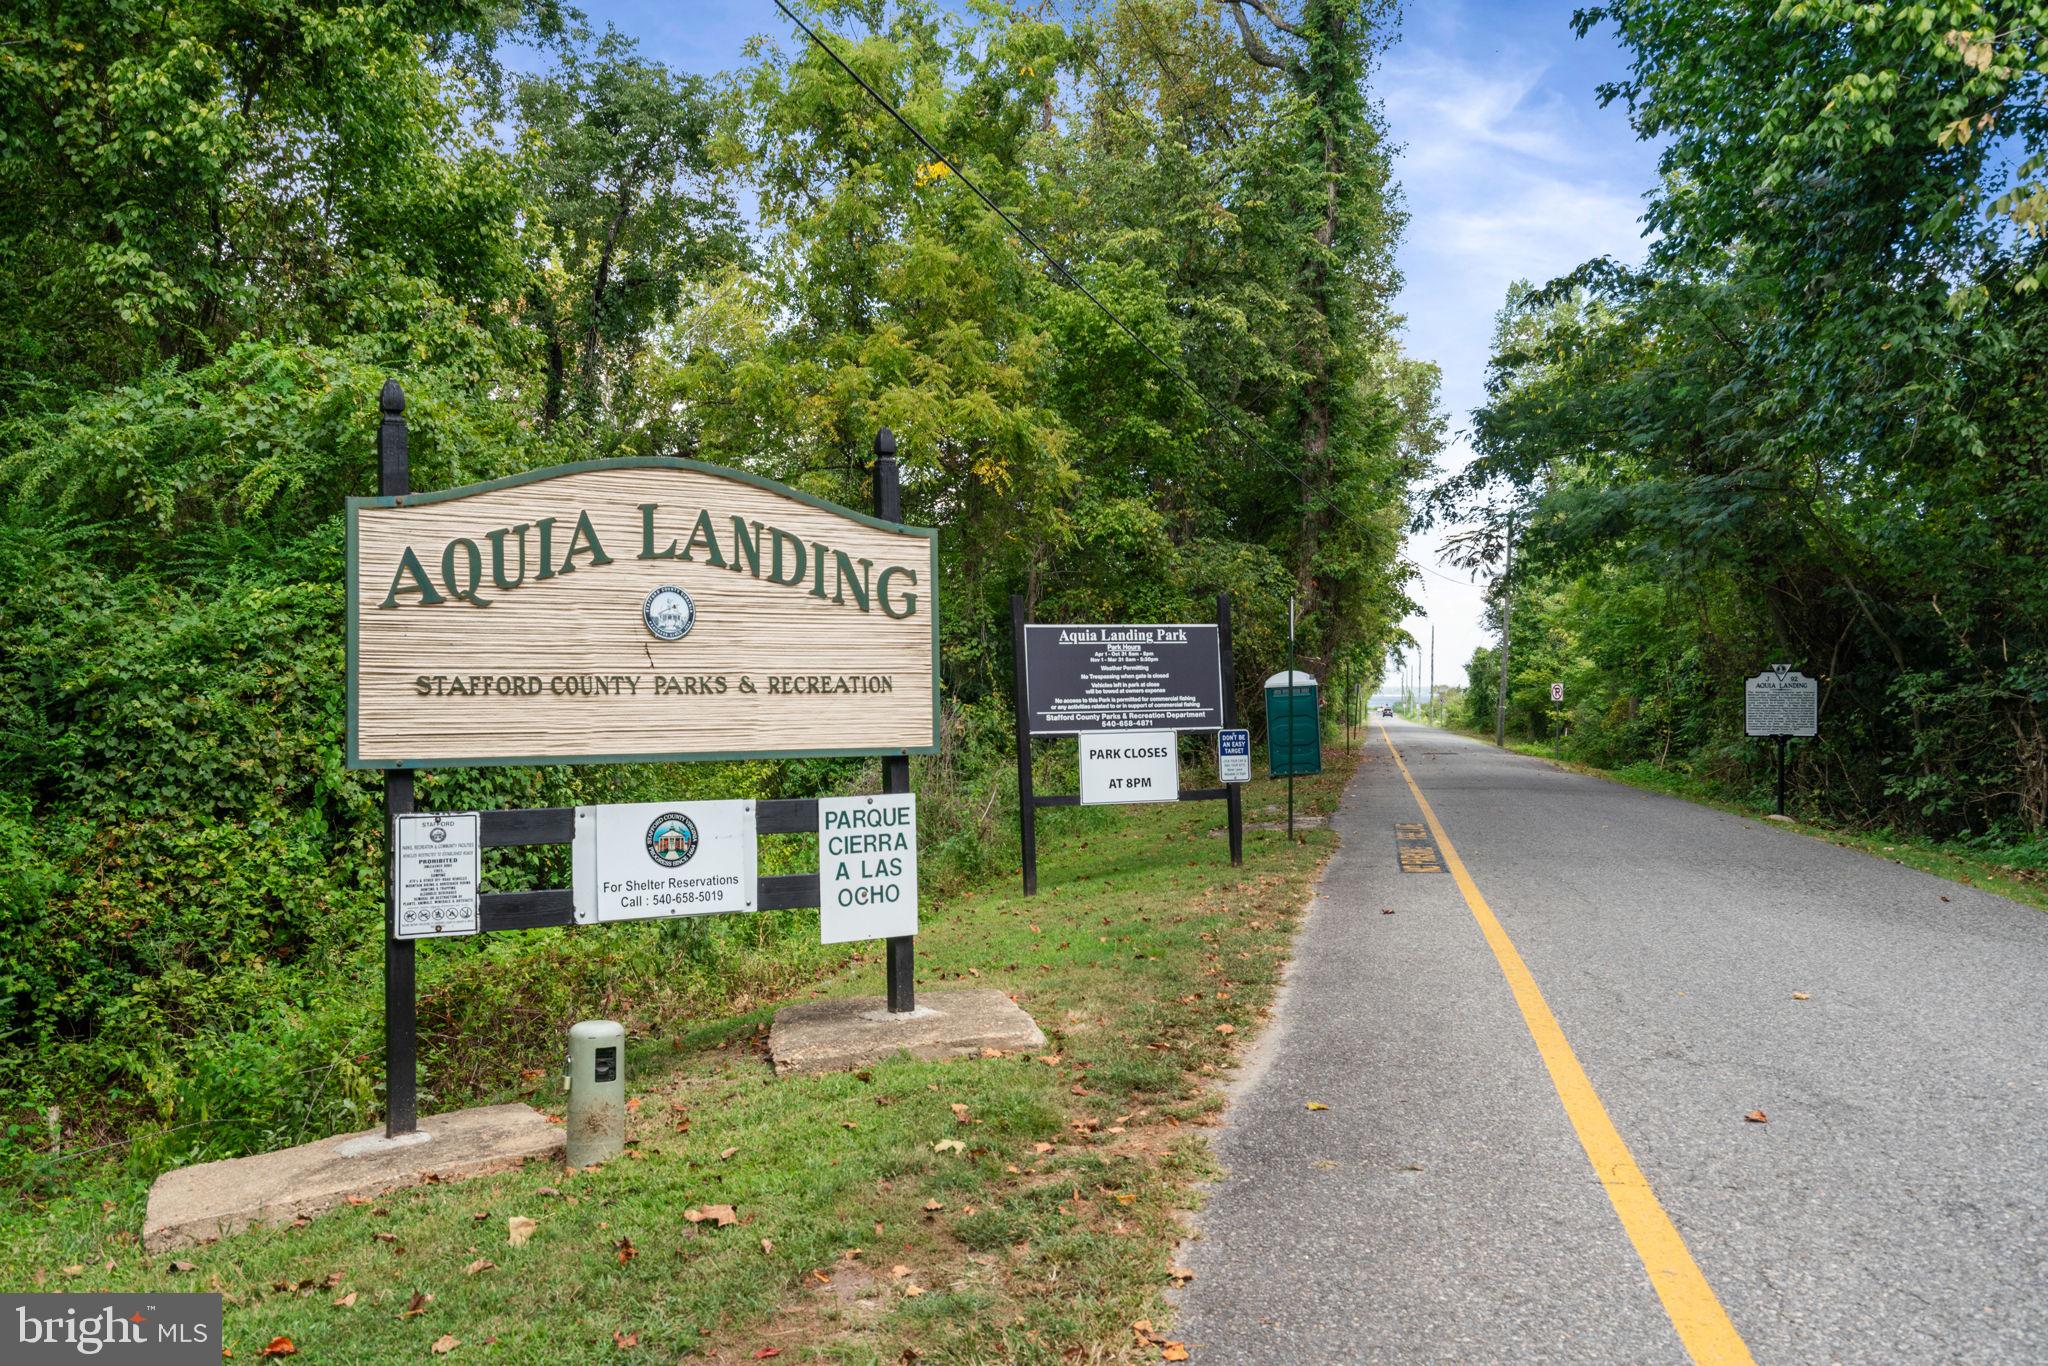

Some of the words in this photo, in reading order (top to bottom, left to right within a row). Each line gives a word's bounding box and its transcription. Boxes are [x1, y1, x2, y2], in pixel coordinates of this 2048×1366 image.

[378, 509, 615, 609] AQUIA
[636, 503, 918, 620] LANDING
[1059, 629, 1098, 644] Aquia
[1101, 629, 1154, 643] Landing
[1157, 629, 1187, 640] Park
[416, 676, 542, 697] STAFFORD
[550, 675, 641, 696] COUNTY
[654, 675, 728, 694] PARKS
[739, 676, 758, 694] &
[767, 675, 893, 695] RECREATION
[1166, 711, 1206, 719] Department
[1090, 748, 1121, 759] PARK
[1124, 747, 1168, 759] CLOSES
[1109, 779, 1124, 789] AT
[1127, 778, 1151, 788] 8PM
[825, 807, 911, 830] PARQUE
[828, 833, 908, 855] CIERRA
[835, 862, 850, 881] A
[862, 858, 902, 878] LAS
[603, 881, 623, 892] For
[625, 878, 667, 891] Shelter
[669, 874, 739, 889] Reservations
[621, 896, 641, 907] Call
[653, 890, 724, 906] 540-658-5019
[838, 884, 900, 907] OCHO
